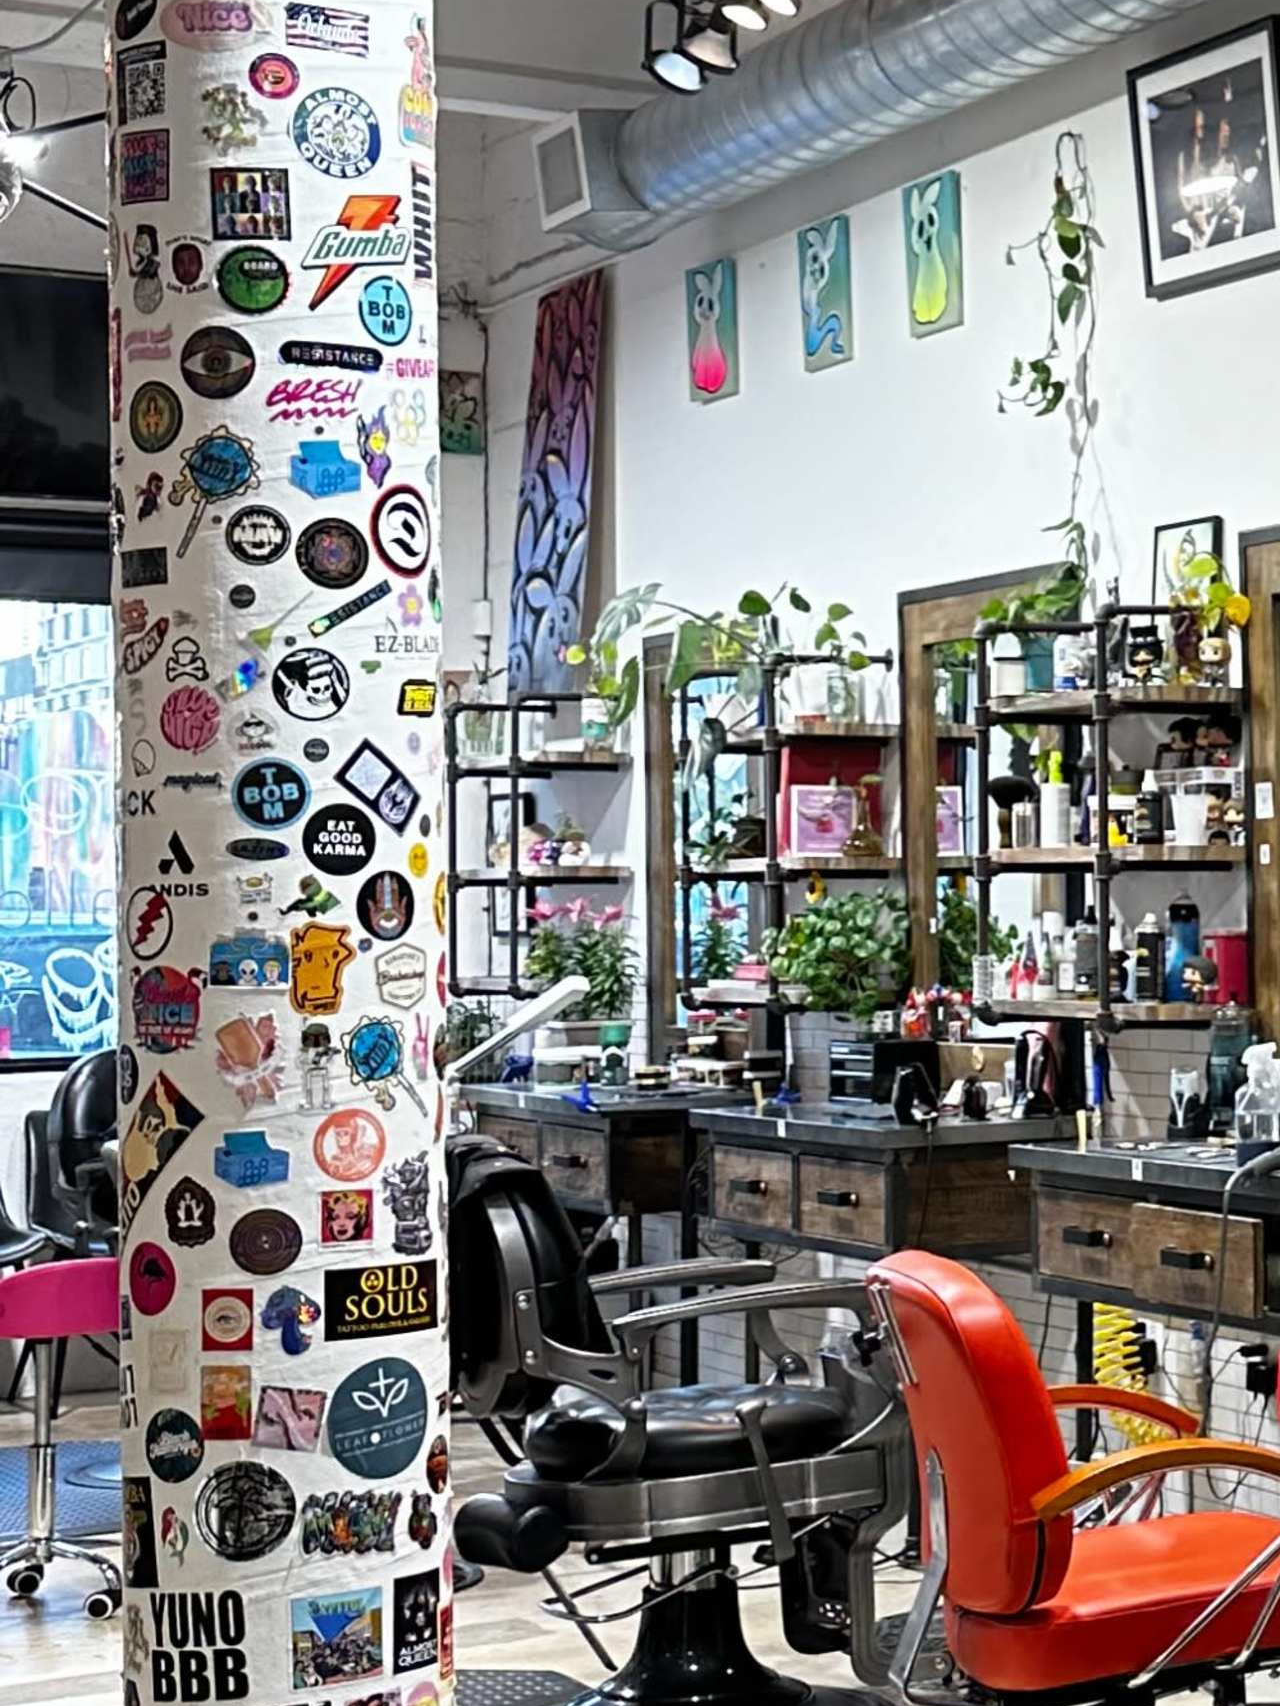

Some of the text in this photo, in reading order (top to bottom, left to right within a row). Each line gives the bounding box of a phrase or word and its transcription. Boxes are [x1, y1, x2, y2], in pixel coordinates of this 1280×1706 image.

[175, 0, 255, 34] Nice
[304, 88, 377, 125] ALMOST
[300, 143, 371, 178] QUEEN
[312, 229, 407, 260] Gumba
[291, 346, 376, 366] RESISTANCE
[318, 831, 362, 844] GOOD
[326, 820, 356, 833] EAT
[313, 843, 366, 858] KARMA
[149, 883, 210, 898] ANDIS
[360, 1264, 419, 1293] OLD
[345, 1287, 429, 1322] SOULS
[150, 1590, 246, 1649] YUNO
[152, 1647, 250, 1702] BBB
